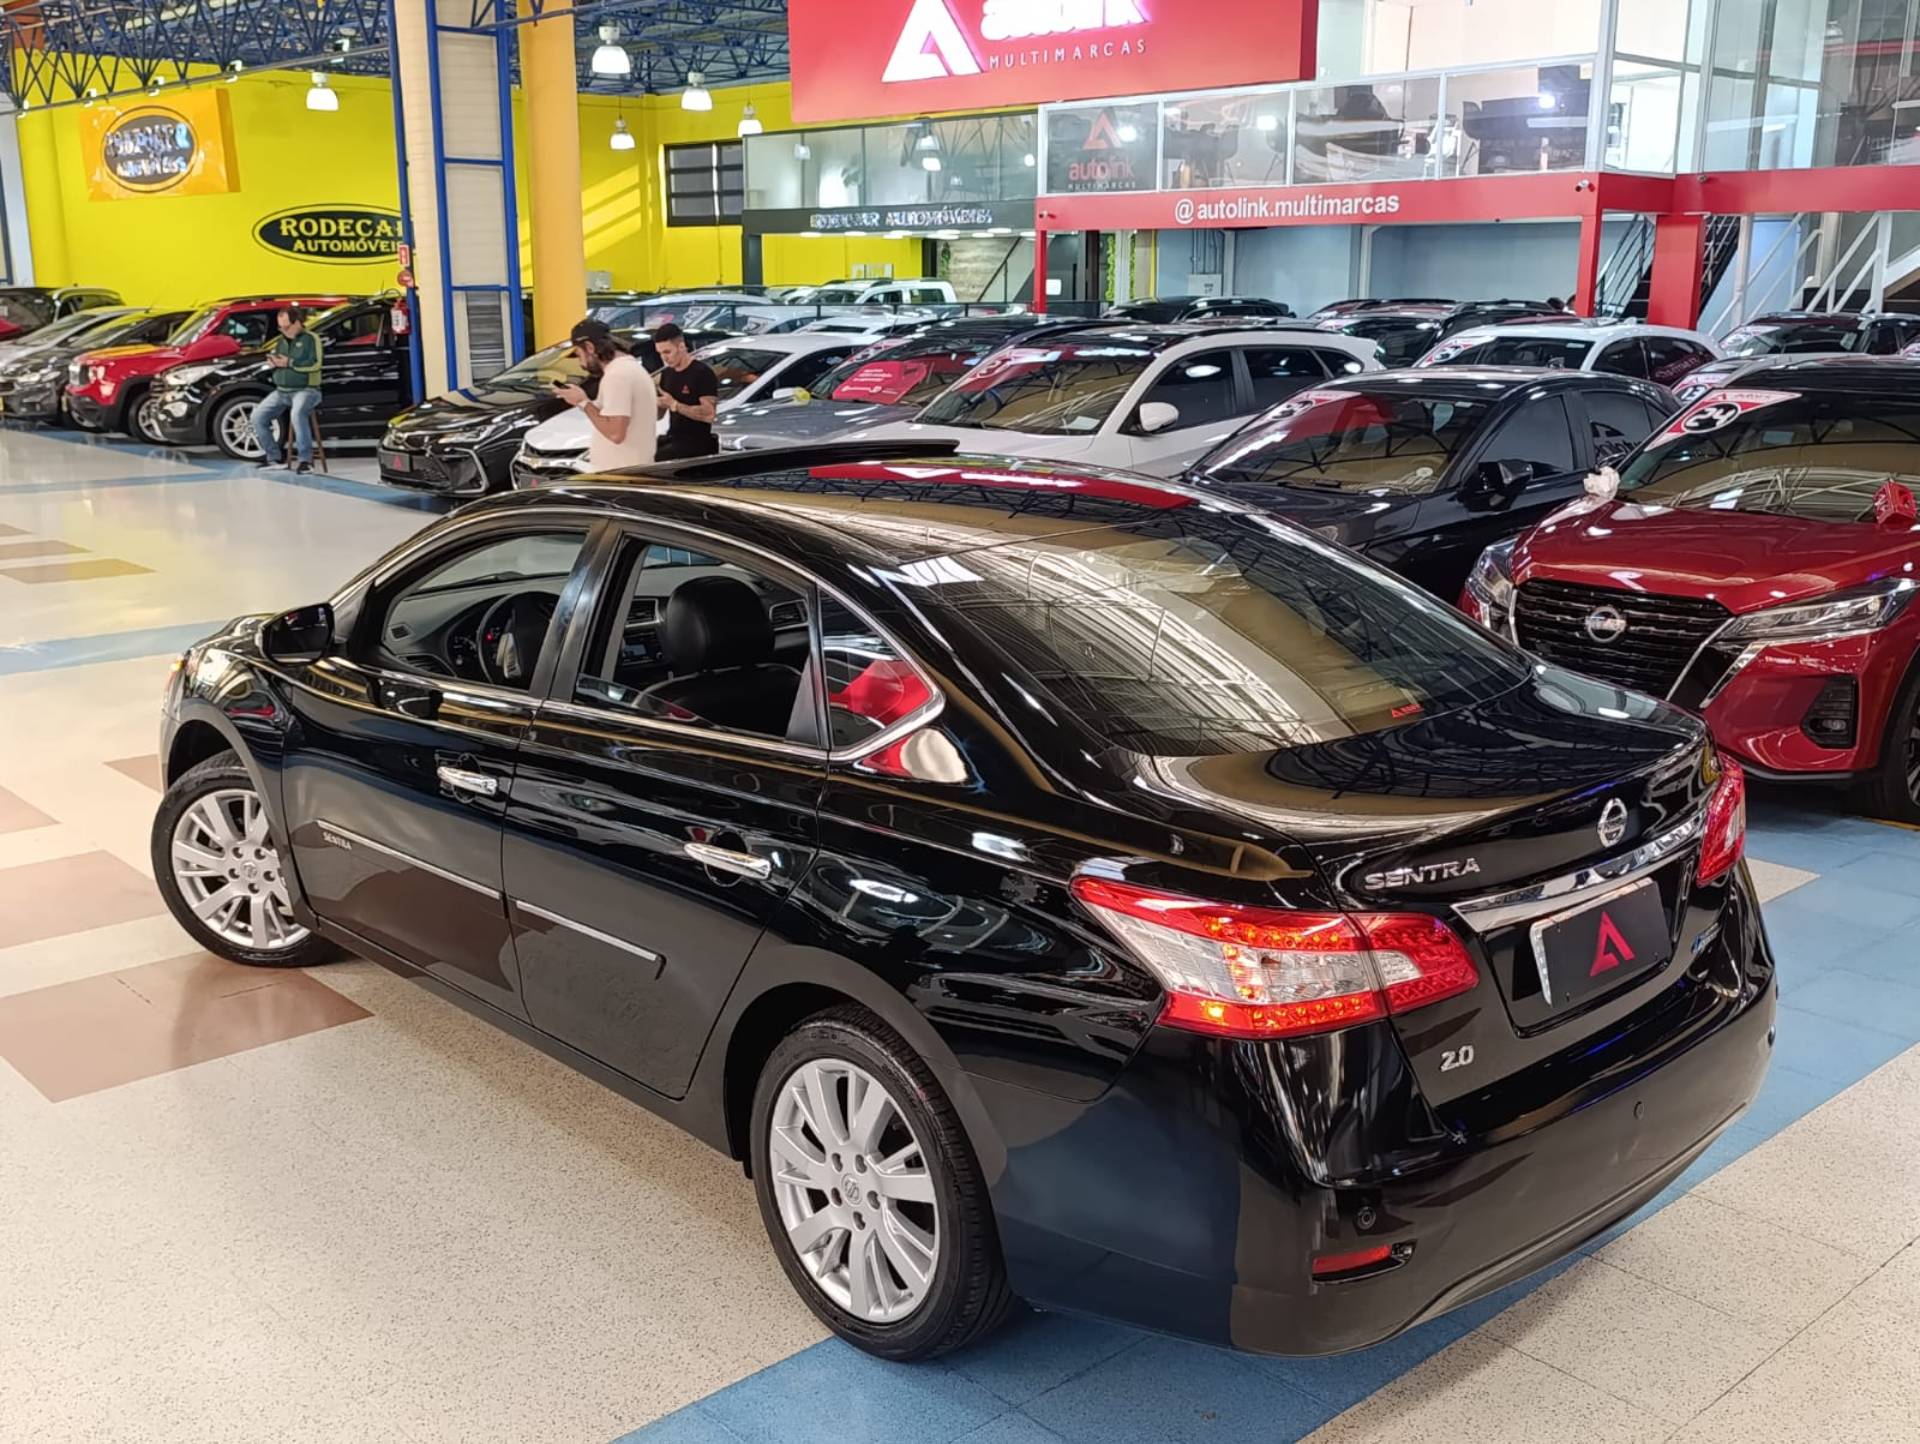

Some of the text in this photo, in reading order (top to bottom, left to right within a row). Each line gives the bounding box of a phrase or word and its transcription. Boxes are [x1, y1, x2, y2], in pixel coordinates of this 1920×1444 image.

[989, 39, 1147, 71] MULTIMARCAS
[1685, 407, 1735, 427] 24
[1364, 857, 1481, 890] SENTRA
